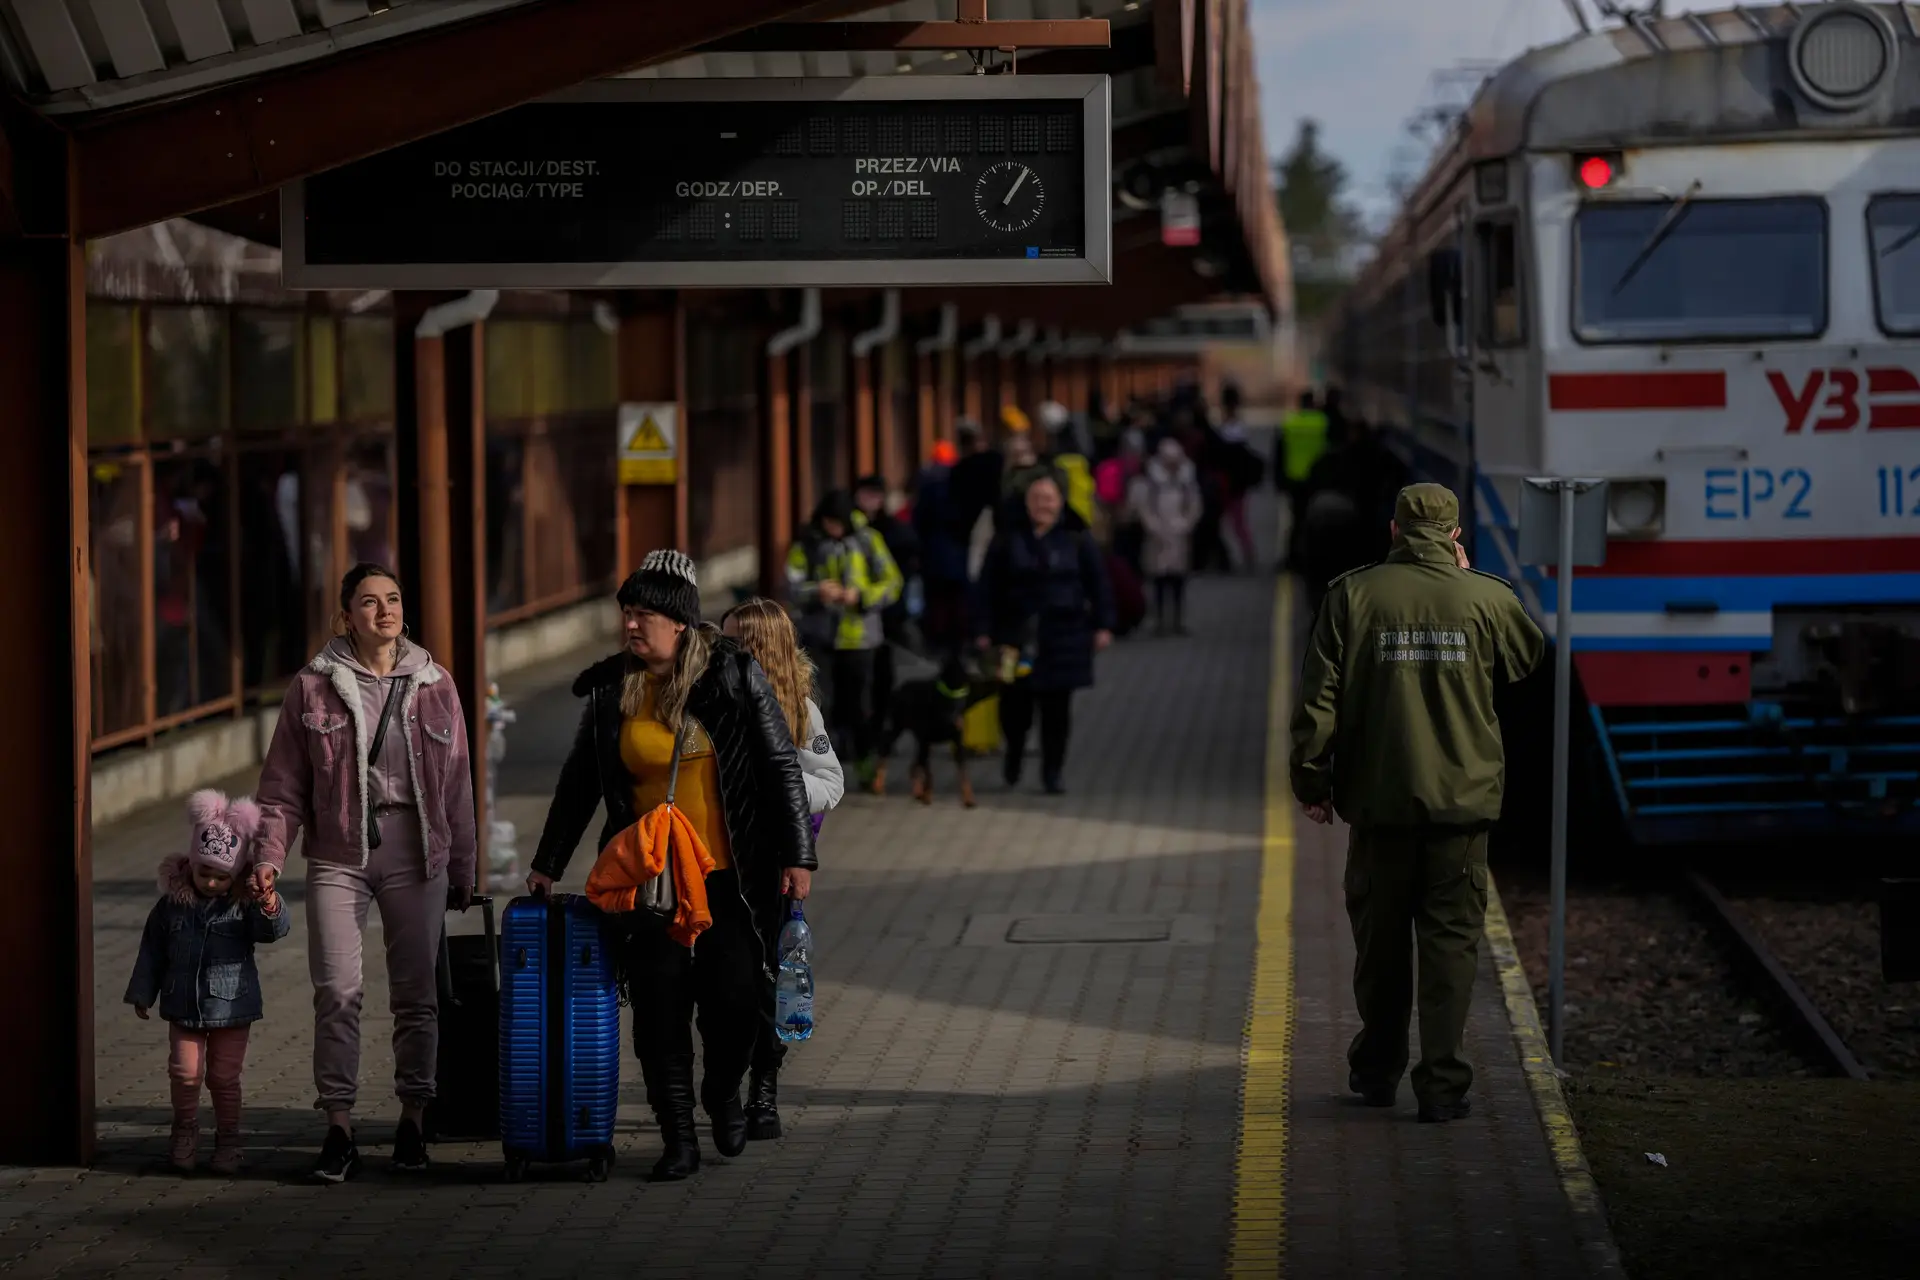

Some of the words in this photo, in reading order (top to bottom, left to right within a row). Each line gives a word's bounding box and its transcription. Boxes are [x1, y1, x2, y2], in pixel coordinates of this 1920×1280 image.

[433, 160, 462, 177] DO
[468, 160, 600, 177] STACJI/DEST.
[855, 157, 962, 174] PRZEZ/VIA
[450, 183, 584, 200] POCIĄG/TYPE
[675, 181, 783, 197] GODZ/DEP.
[851, 180, 931, 196] OP./DEL
[1380, 631, 1410, 646] STRAŻ
[1412, 631, 1467, 646] GRANICZNA
[1381, 649, 1408, 662] POLISH
[1409, 649, 1440, 661] BORDER
[1441, 650, 1466, 662] GUARD
